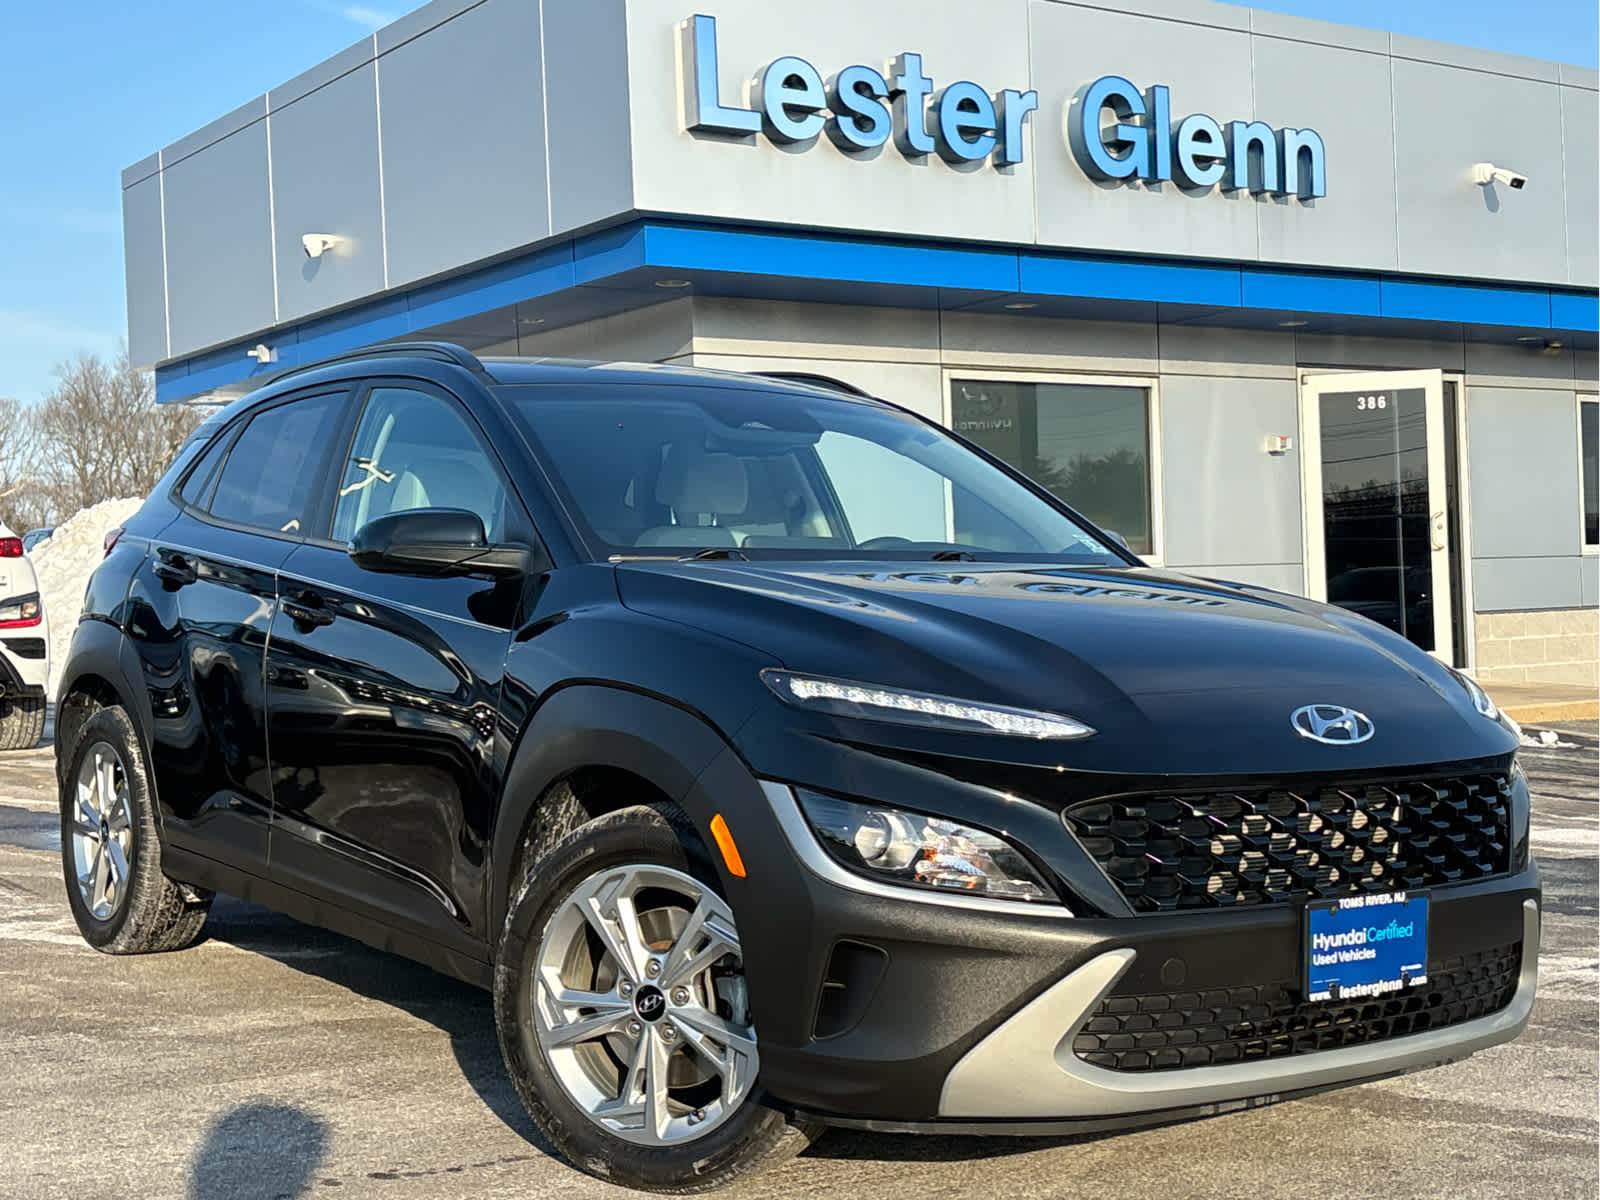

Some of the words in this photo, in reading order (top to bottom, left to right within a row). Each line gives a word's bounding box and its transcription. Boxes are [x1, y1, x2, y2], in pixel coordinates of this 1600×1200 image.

[687, 14, 1038, 166] Lester
[1069, 75, 1326, 200] Glenn
[1357, 396, 1387, 410] 386
[1339, 896, 1364, 909] TOMS
[1393, 891, 1406, 902] NJ
[1313, 928, 1367, 951] Hyundai
[1367, 919, 1413, 942] Certified
[1313, 953, 1338, 965] Used
[1339, 948, 1376, 961] Vehicles
[1339, 979, 1403, 999] lesterglenn
